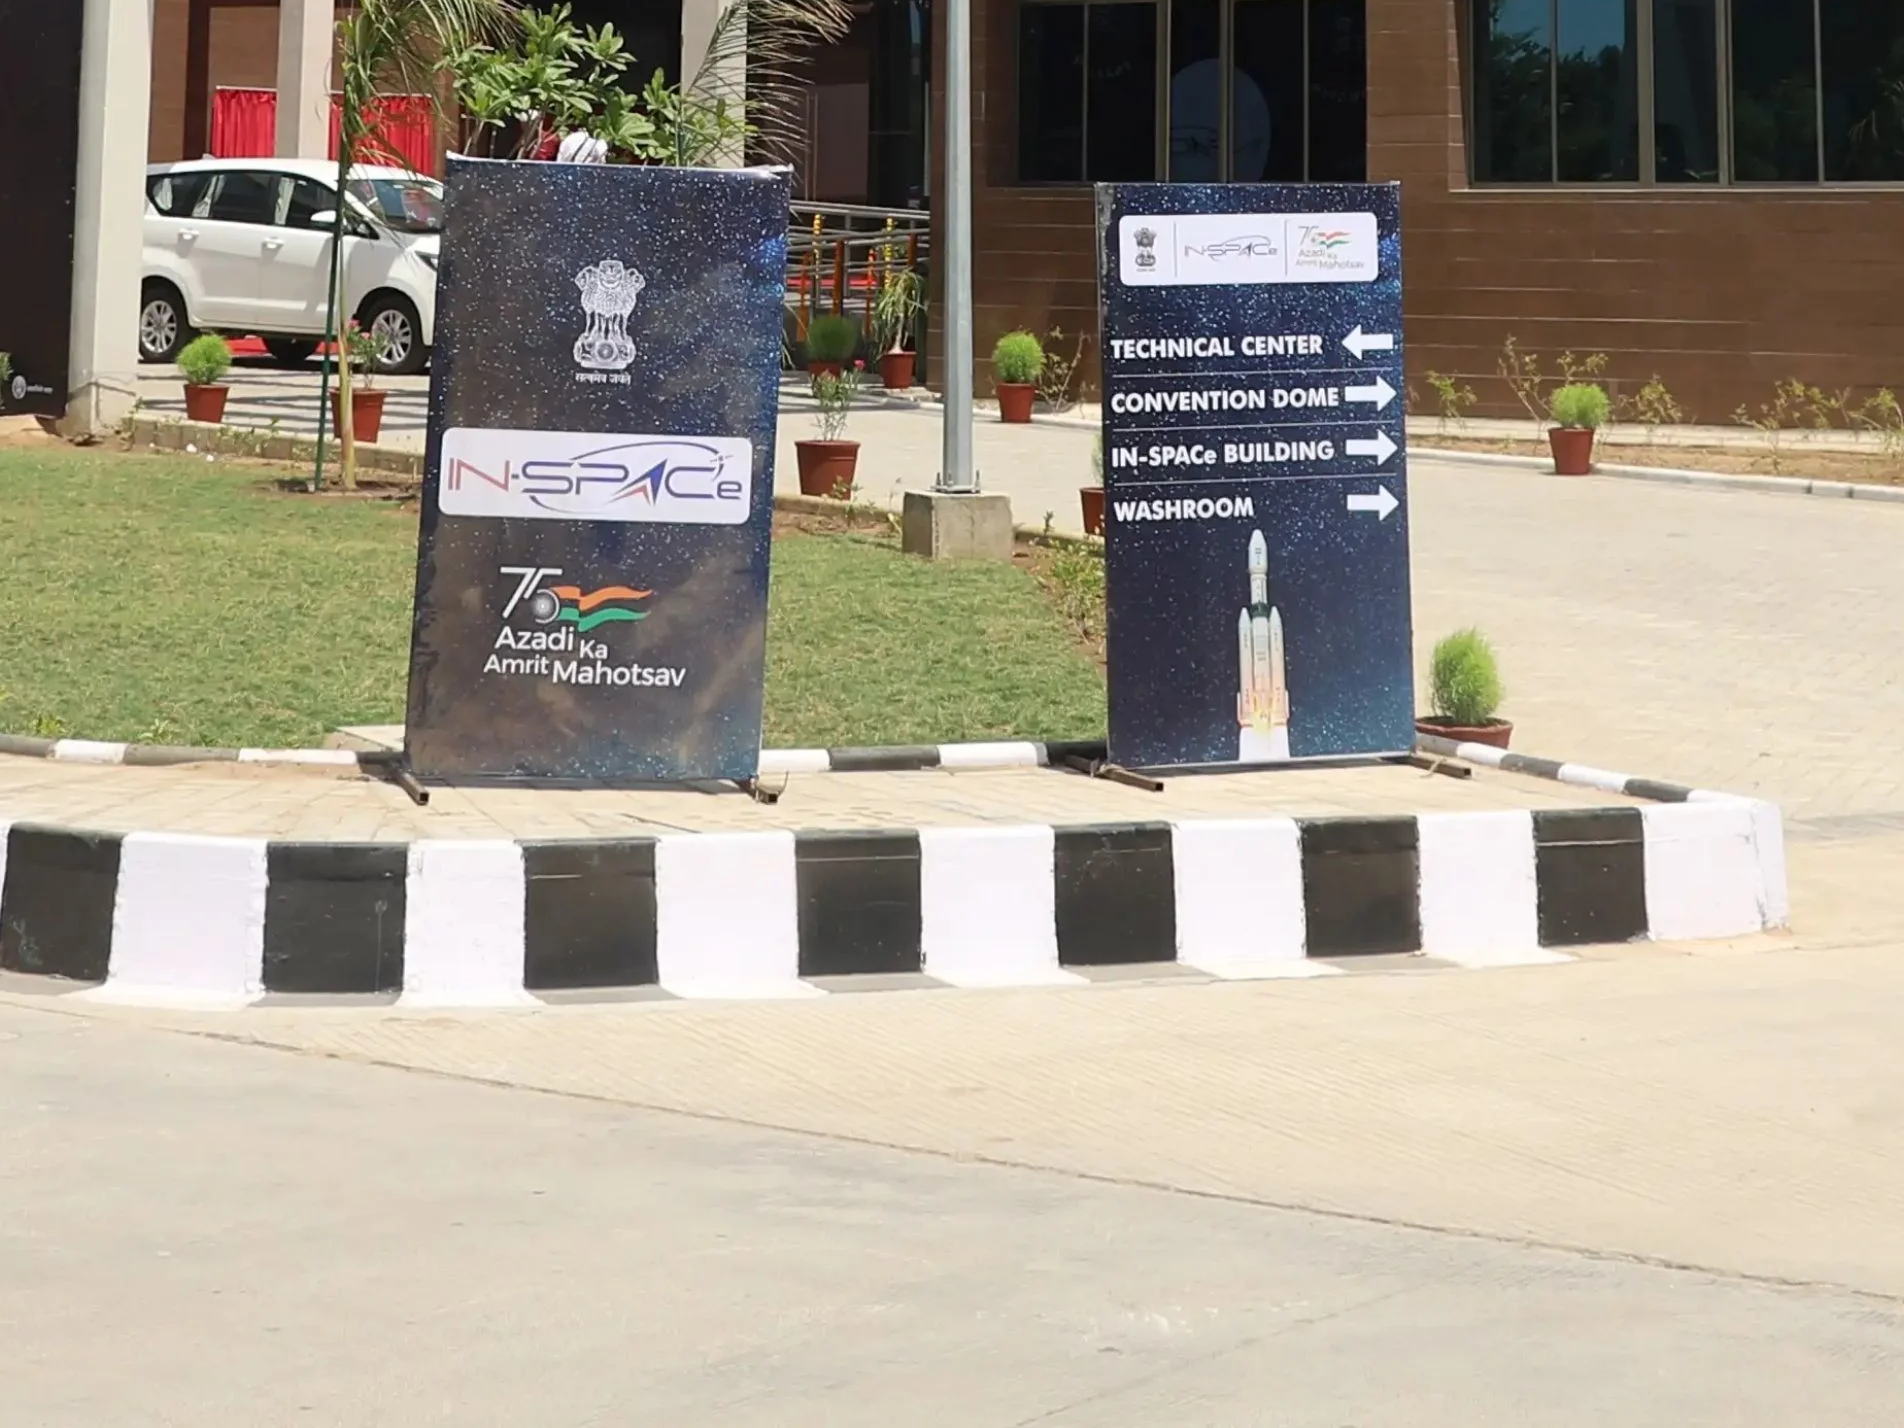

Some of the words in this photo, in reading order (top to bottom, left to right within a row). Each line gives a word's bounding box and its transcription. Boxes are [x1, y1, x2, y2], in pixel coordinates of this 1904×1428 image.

[1110, 336, 1235, 360] TECHNICAL
[1241, 335, 1323, 356] CENTER
[1110, 389, 1265, 413] CONVENTION
[1273, 387, 1339, 408] DOME
[1112, 445, 1217, 467] IN-SPACe
[1224, 440, 1335, 464] BUILDING
[1114, 497, 1254, 522] WASHROOM
[494, 625, 574, 651] Azadi
[579, 639, 608, 660] Ka
[483, 653, 549, 675] Amrit
[552, 660, 686, 687] Mahotsav
